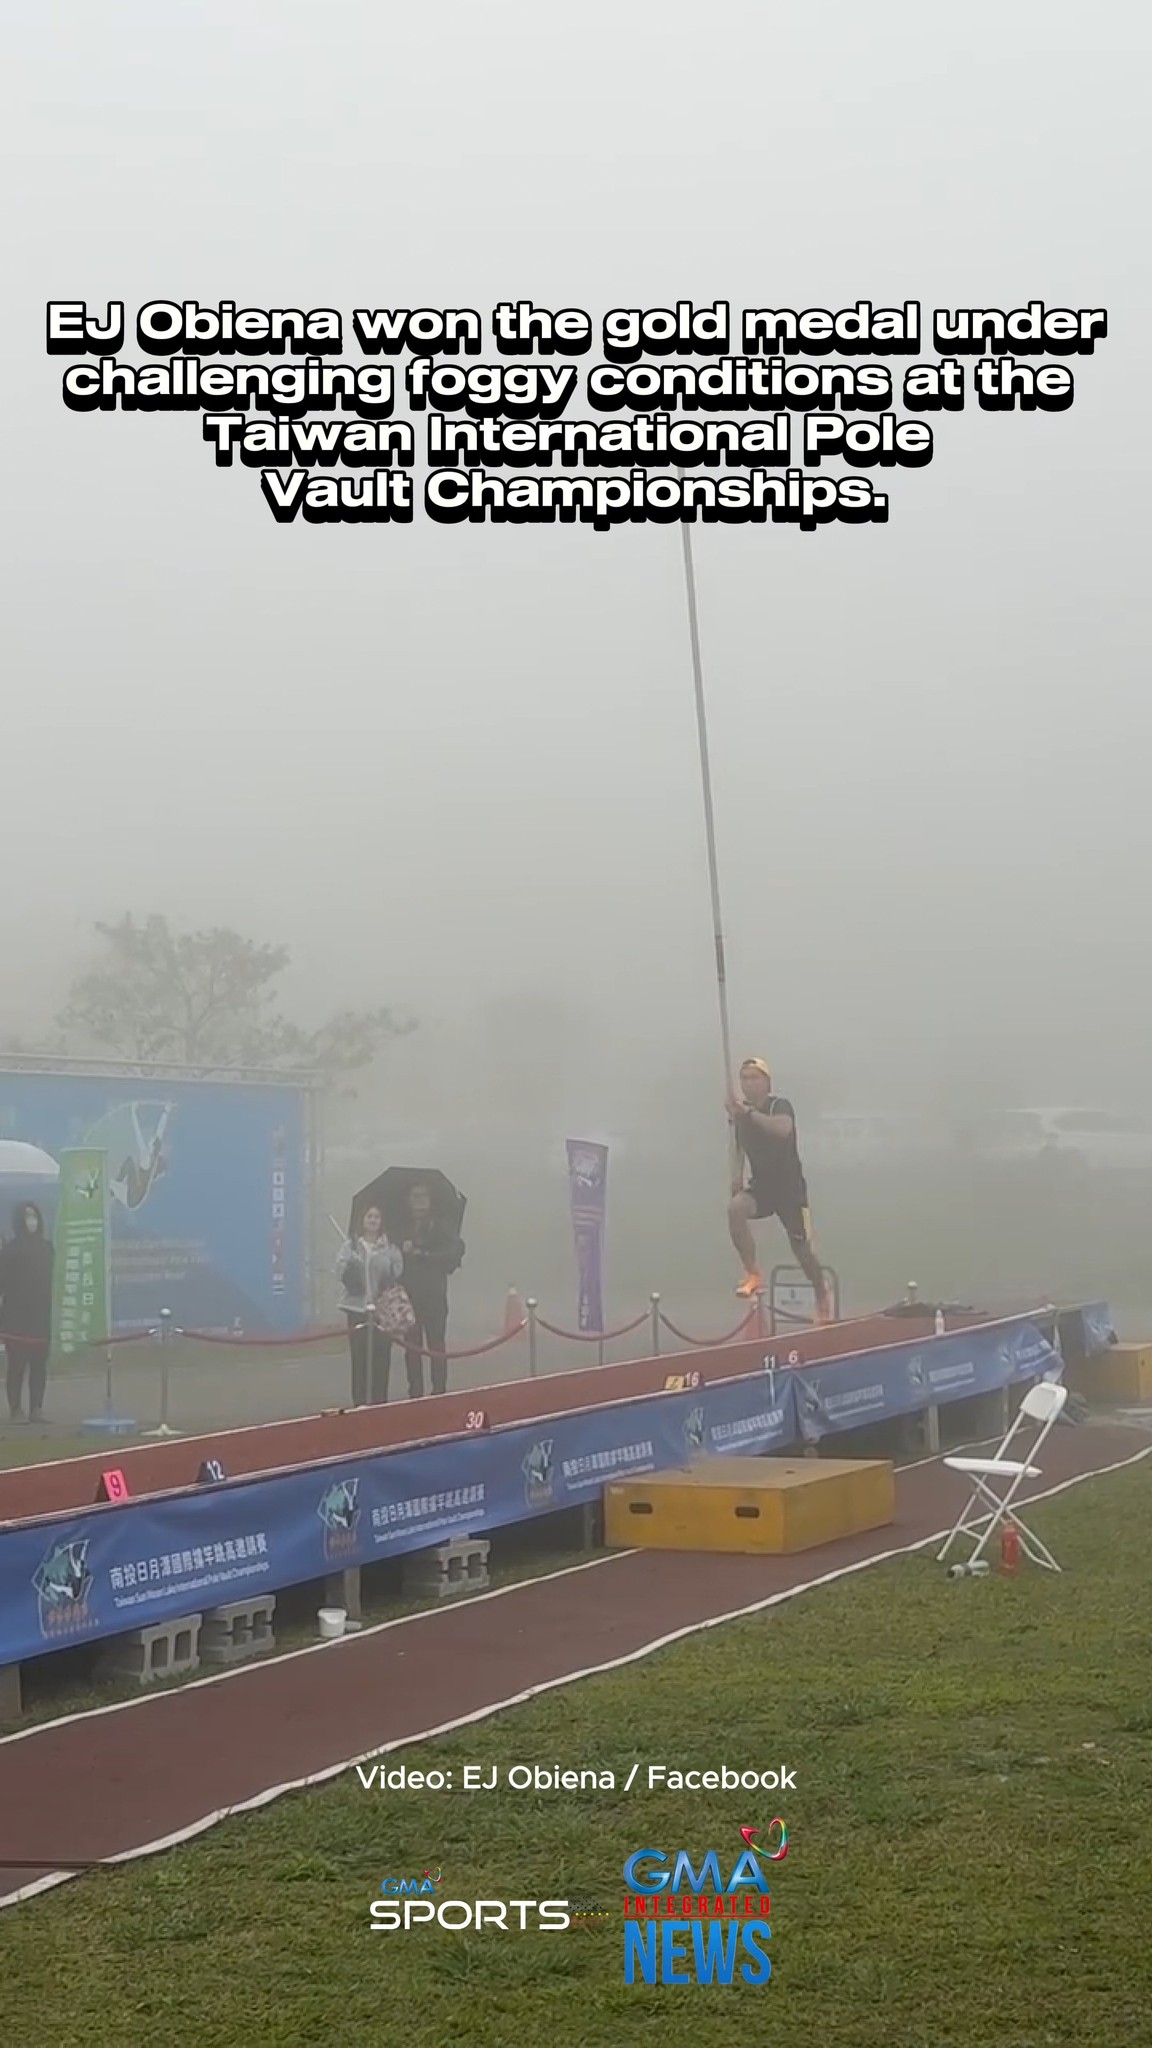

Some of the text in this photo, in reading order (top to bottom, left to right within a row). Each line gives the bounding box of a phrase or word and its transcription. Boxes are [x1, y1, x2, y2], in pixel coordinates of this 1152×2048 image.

[763, 1355, 776, 1369] 11
[788, 1350, 799, 1365] 6
[685, 1371, 700, 1387] 16
[465, 1411, 485, 1428] 30
[206, 1460, 226, 1481] 12
[110, 1474, 121, 1497] 9
